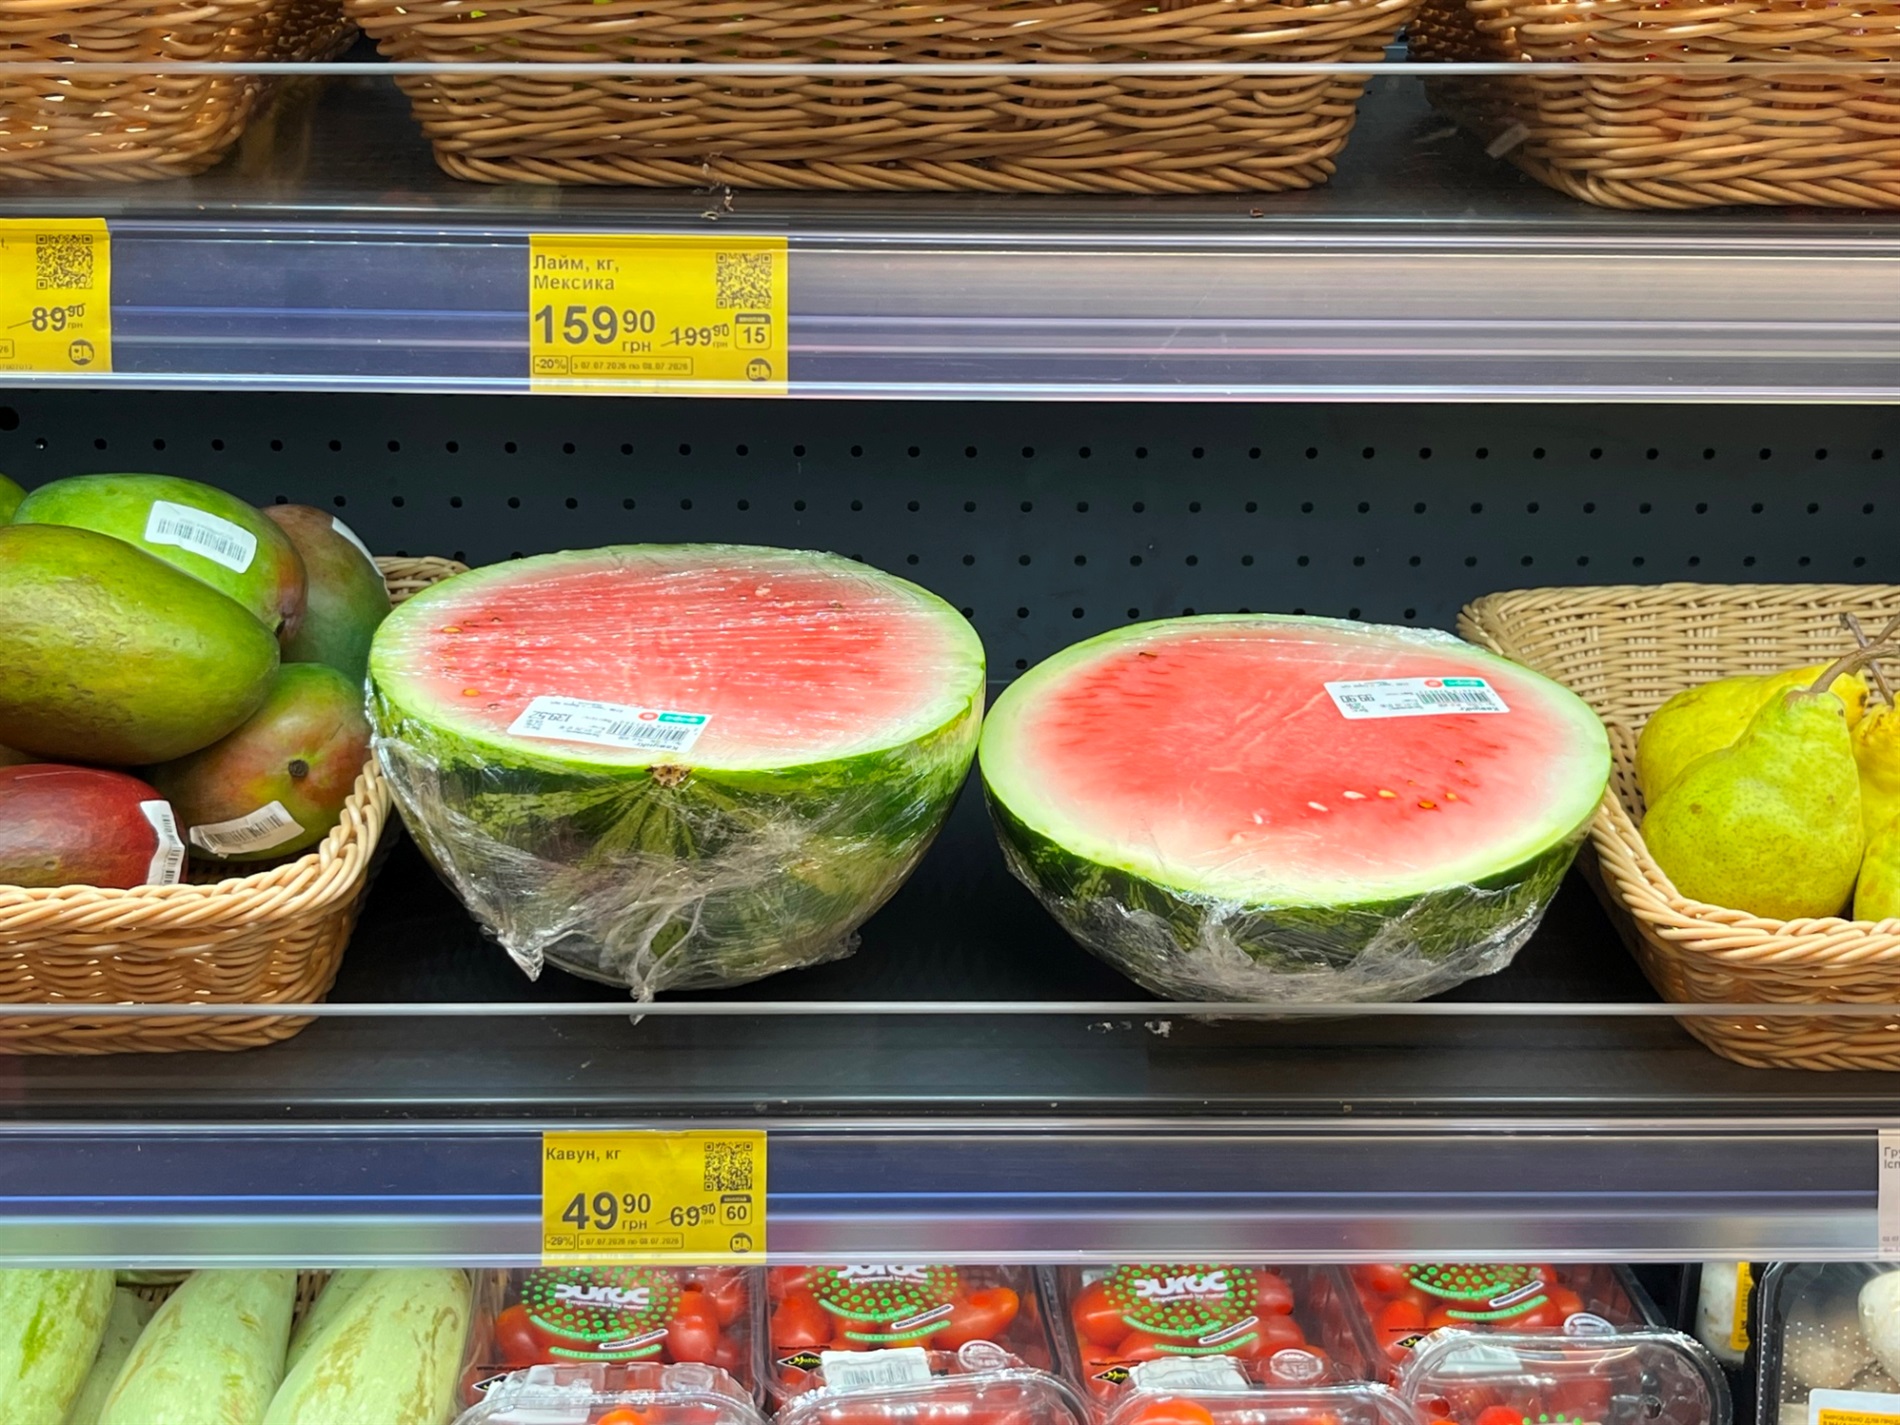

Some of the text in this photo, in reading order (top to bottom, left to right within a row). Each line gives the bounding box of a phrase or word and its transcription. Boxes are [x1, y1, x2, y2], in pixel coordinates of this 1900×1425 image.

[533, 254, 620, 273] Лайм, кг,
[533, 275, 615, 291] Мексика
[535, 304, 656, 345] 159 90
[742, 327, 766, 345] 15
[622, 340, 652, 354] грн
[535, 358, 567, 370] -20%
[546, 1147, 622, 1163] Кавун, кг
[562, 1191, 652, 1232] 49 90
[726, 1205, 748, 1221] 60
[622, 1219, 648, 1232] грн
